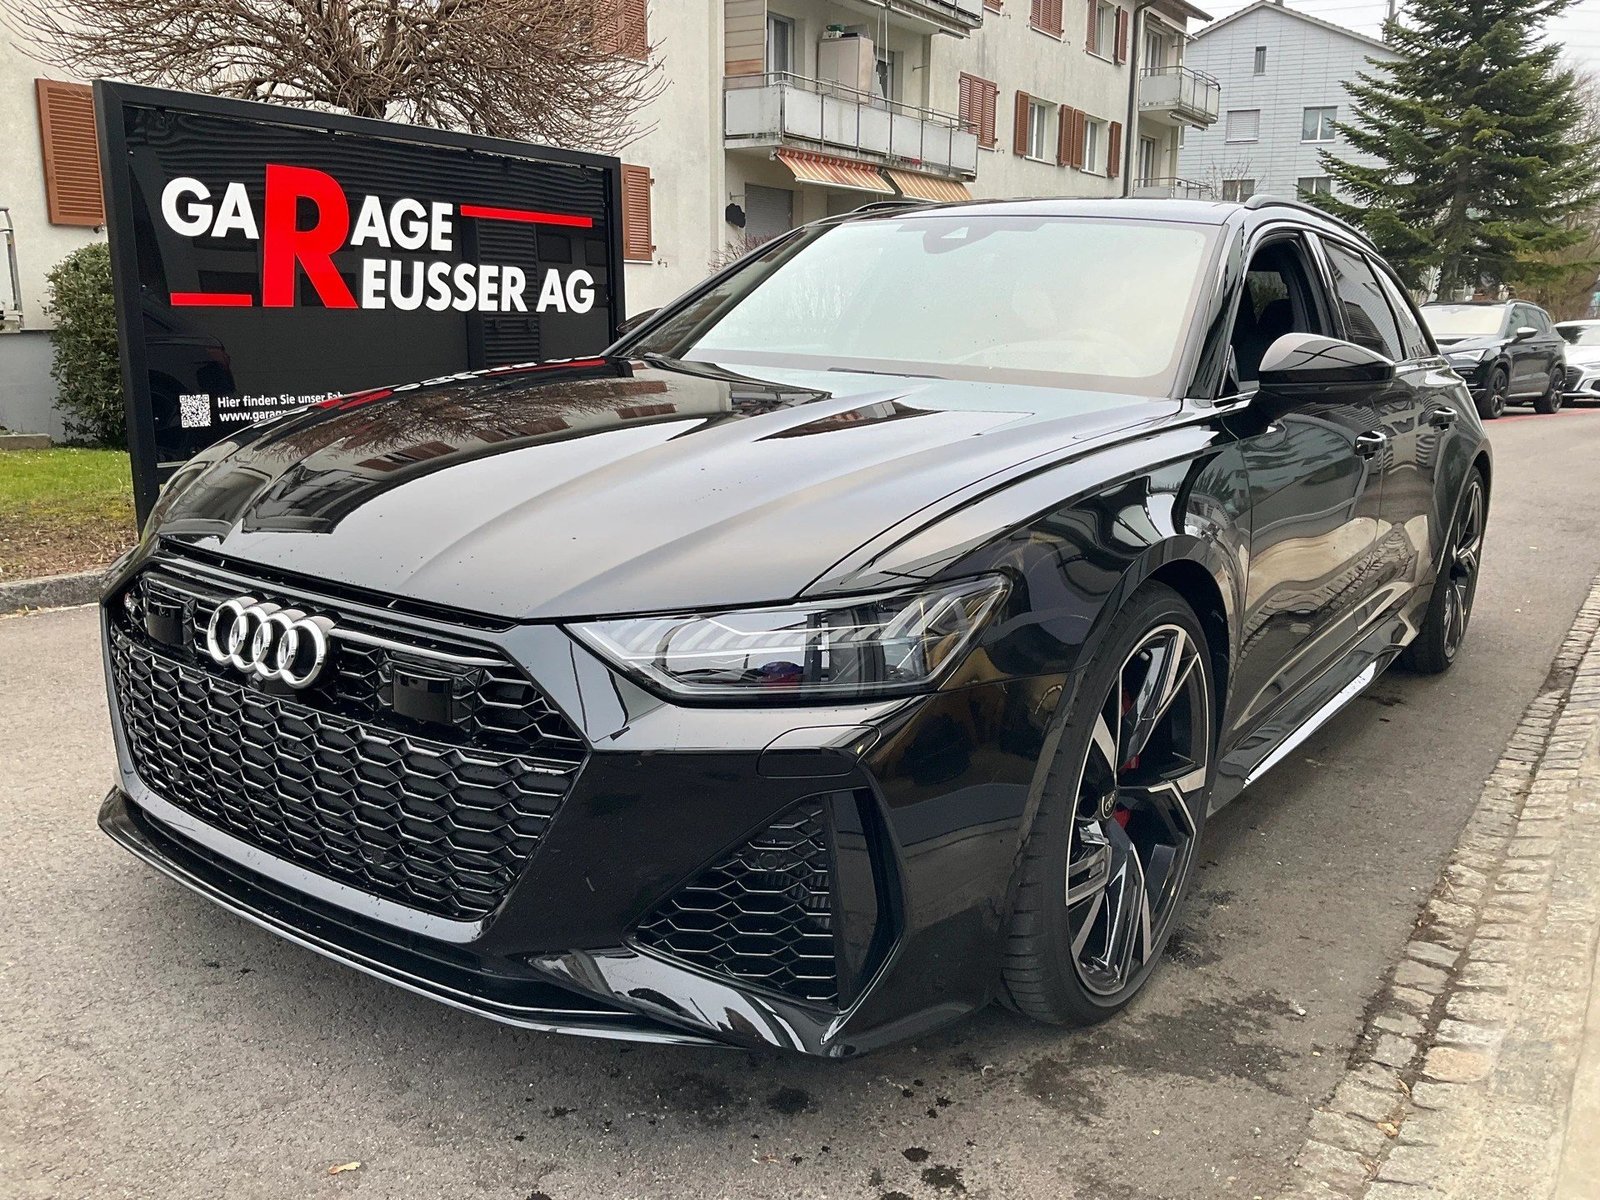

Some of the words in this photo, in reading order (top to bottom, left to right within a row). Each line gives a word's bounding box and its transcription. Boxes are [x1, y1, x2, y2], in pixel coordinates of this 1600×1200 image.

[162, 164, 454, 308] GARAGE
[536, 268, 595, 314] AG
[217, 396, 241, 408] Hier
[242, 394, 278, 407] finden
[280, 393, 296, 405] Sie
[298, 394, 326, 404] unser
